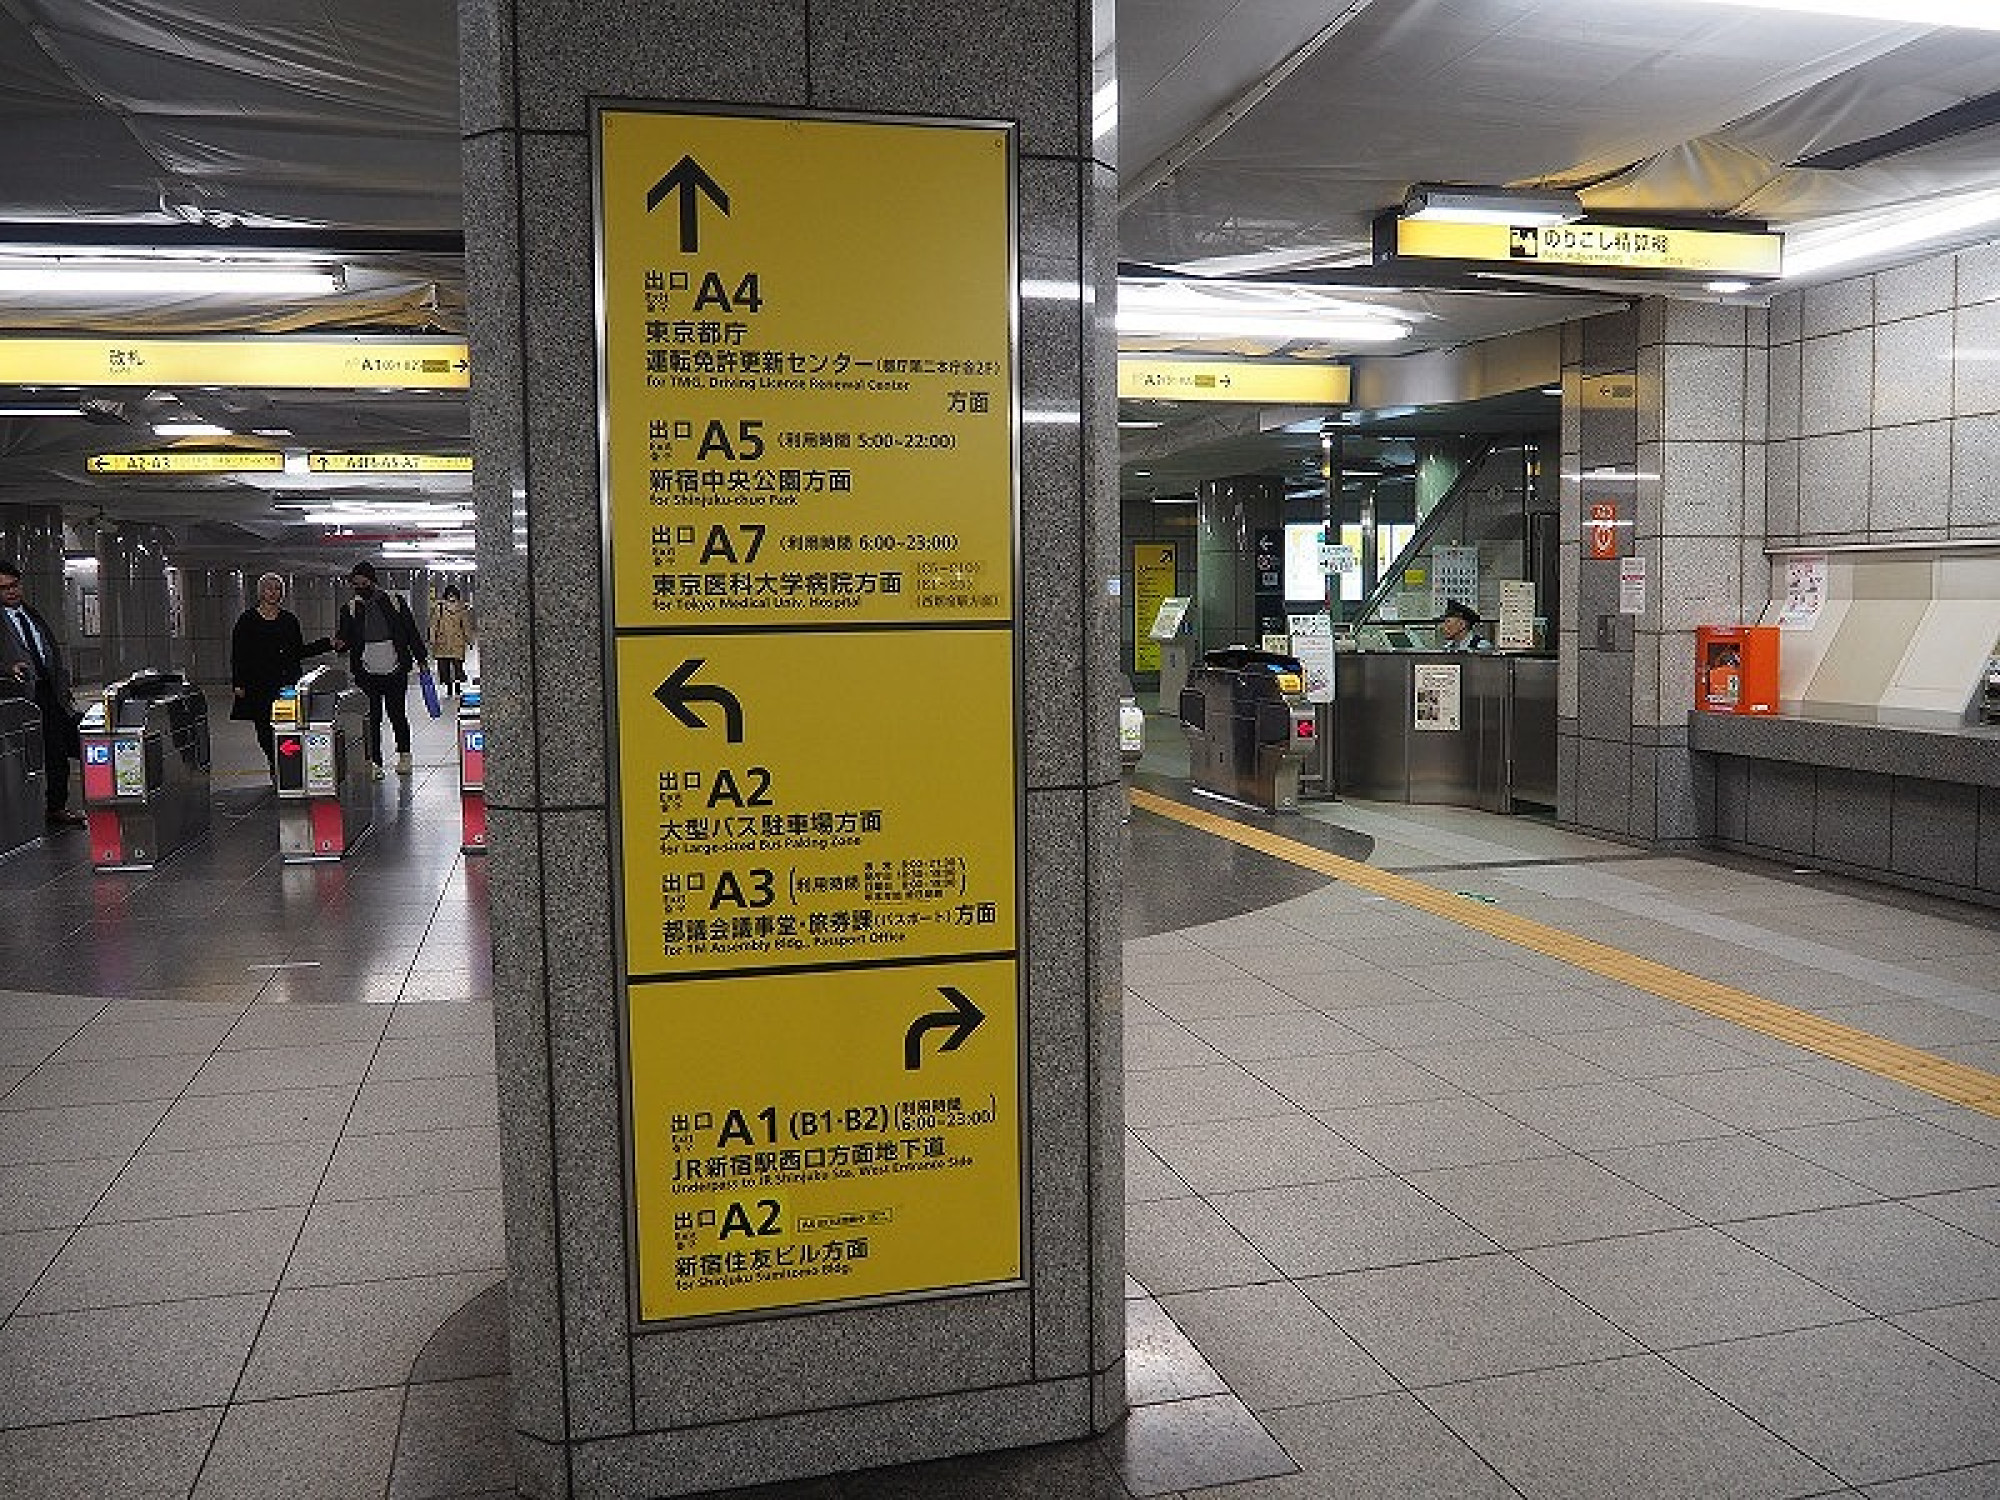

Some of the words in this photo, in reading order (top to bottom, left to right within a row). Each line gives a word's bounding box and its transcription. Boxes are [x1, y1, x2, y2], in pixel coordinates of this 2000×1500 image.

[644, 269, 688, 291] 出口
[692, 271, 763, 314] A4
[645, 320, 748, 346] 東京都庁
[361, 358, 380, 370] A1
[646, 349, 874, 375] 運転免許更新センター
[646, 376, 666, 389] for
[709, 377, 756, 391] Driving
[760, 377, 805, 390] License
[867, 380, 911, 392] Center
[947, 390, 989, 414] 方面
[649, 419, 692, 440] 出口
[697, 419, 766, 461] A5
[649, 469, 852, 493] 新宿中央公園方面
[649, 493, 670, 506] for
[652, 524, 696, 546] 出口
[699, 524, 766, 566] A7
[652, 572, 901, 598] 東京医科大学病院方面
[653, 597, 671, 611] for
[676, 597, 716, 613] Tokyo
[720, 597, 771, 609] Medical
[809, 596, 861, 610] Hospital
[86, 745, 109, 764] IC
[659, 771, 701, 791] 出口
[707, 767, 774, 808] A2
[659, 810, 883, 841] 大型バス駐車場方面
[660, 841, 680, 856] for
[662, 872, 705, 893] 出口
[709, 869, 775, 910] A3
[953, 902, 999, 926] 方面
[664, 943, 683, 956] for
[671, 1112, 714, 1133] 出口
[716, 1106, 776, 1148] A1
[672, 1136, 946, 1181] JR新宿駅西口方面地下道
[742, 1177, 756, 1189] to
[675, 1210, 716, 1231] 出口
[719, 1199, 783, 1241] A2
[675, 1237, 869, 1277] 新宿住友ビル方面
[676, 1279, 694, 1291] for
